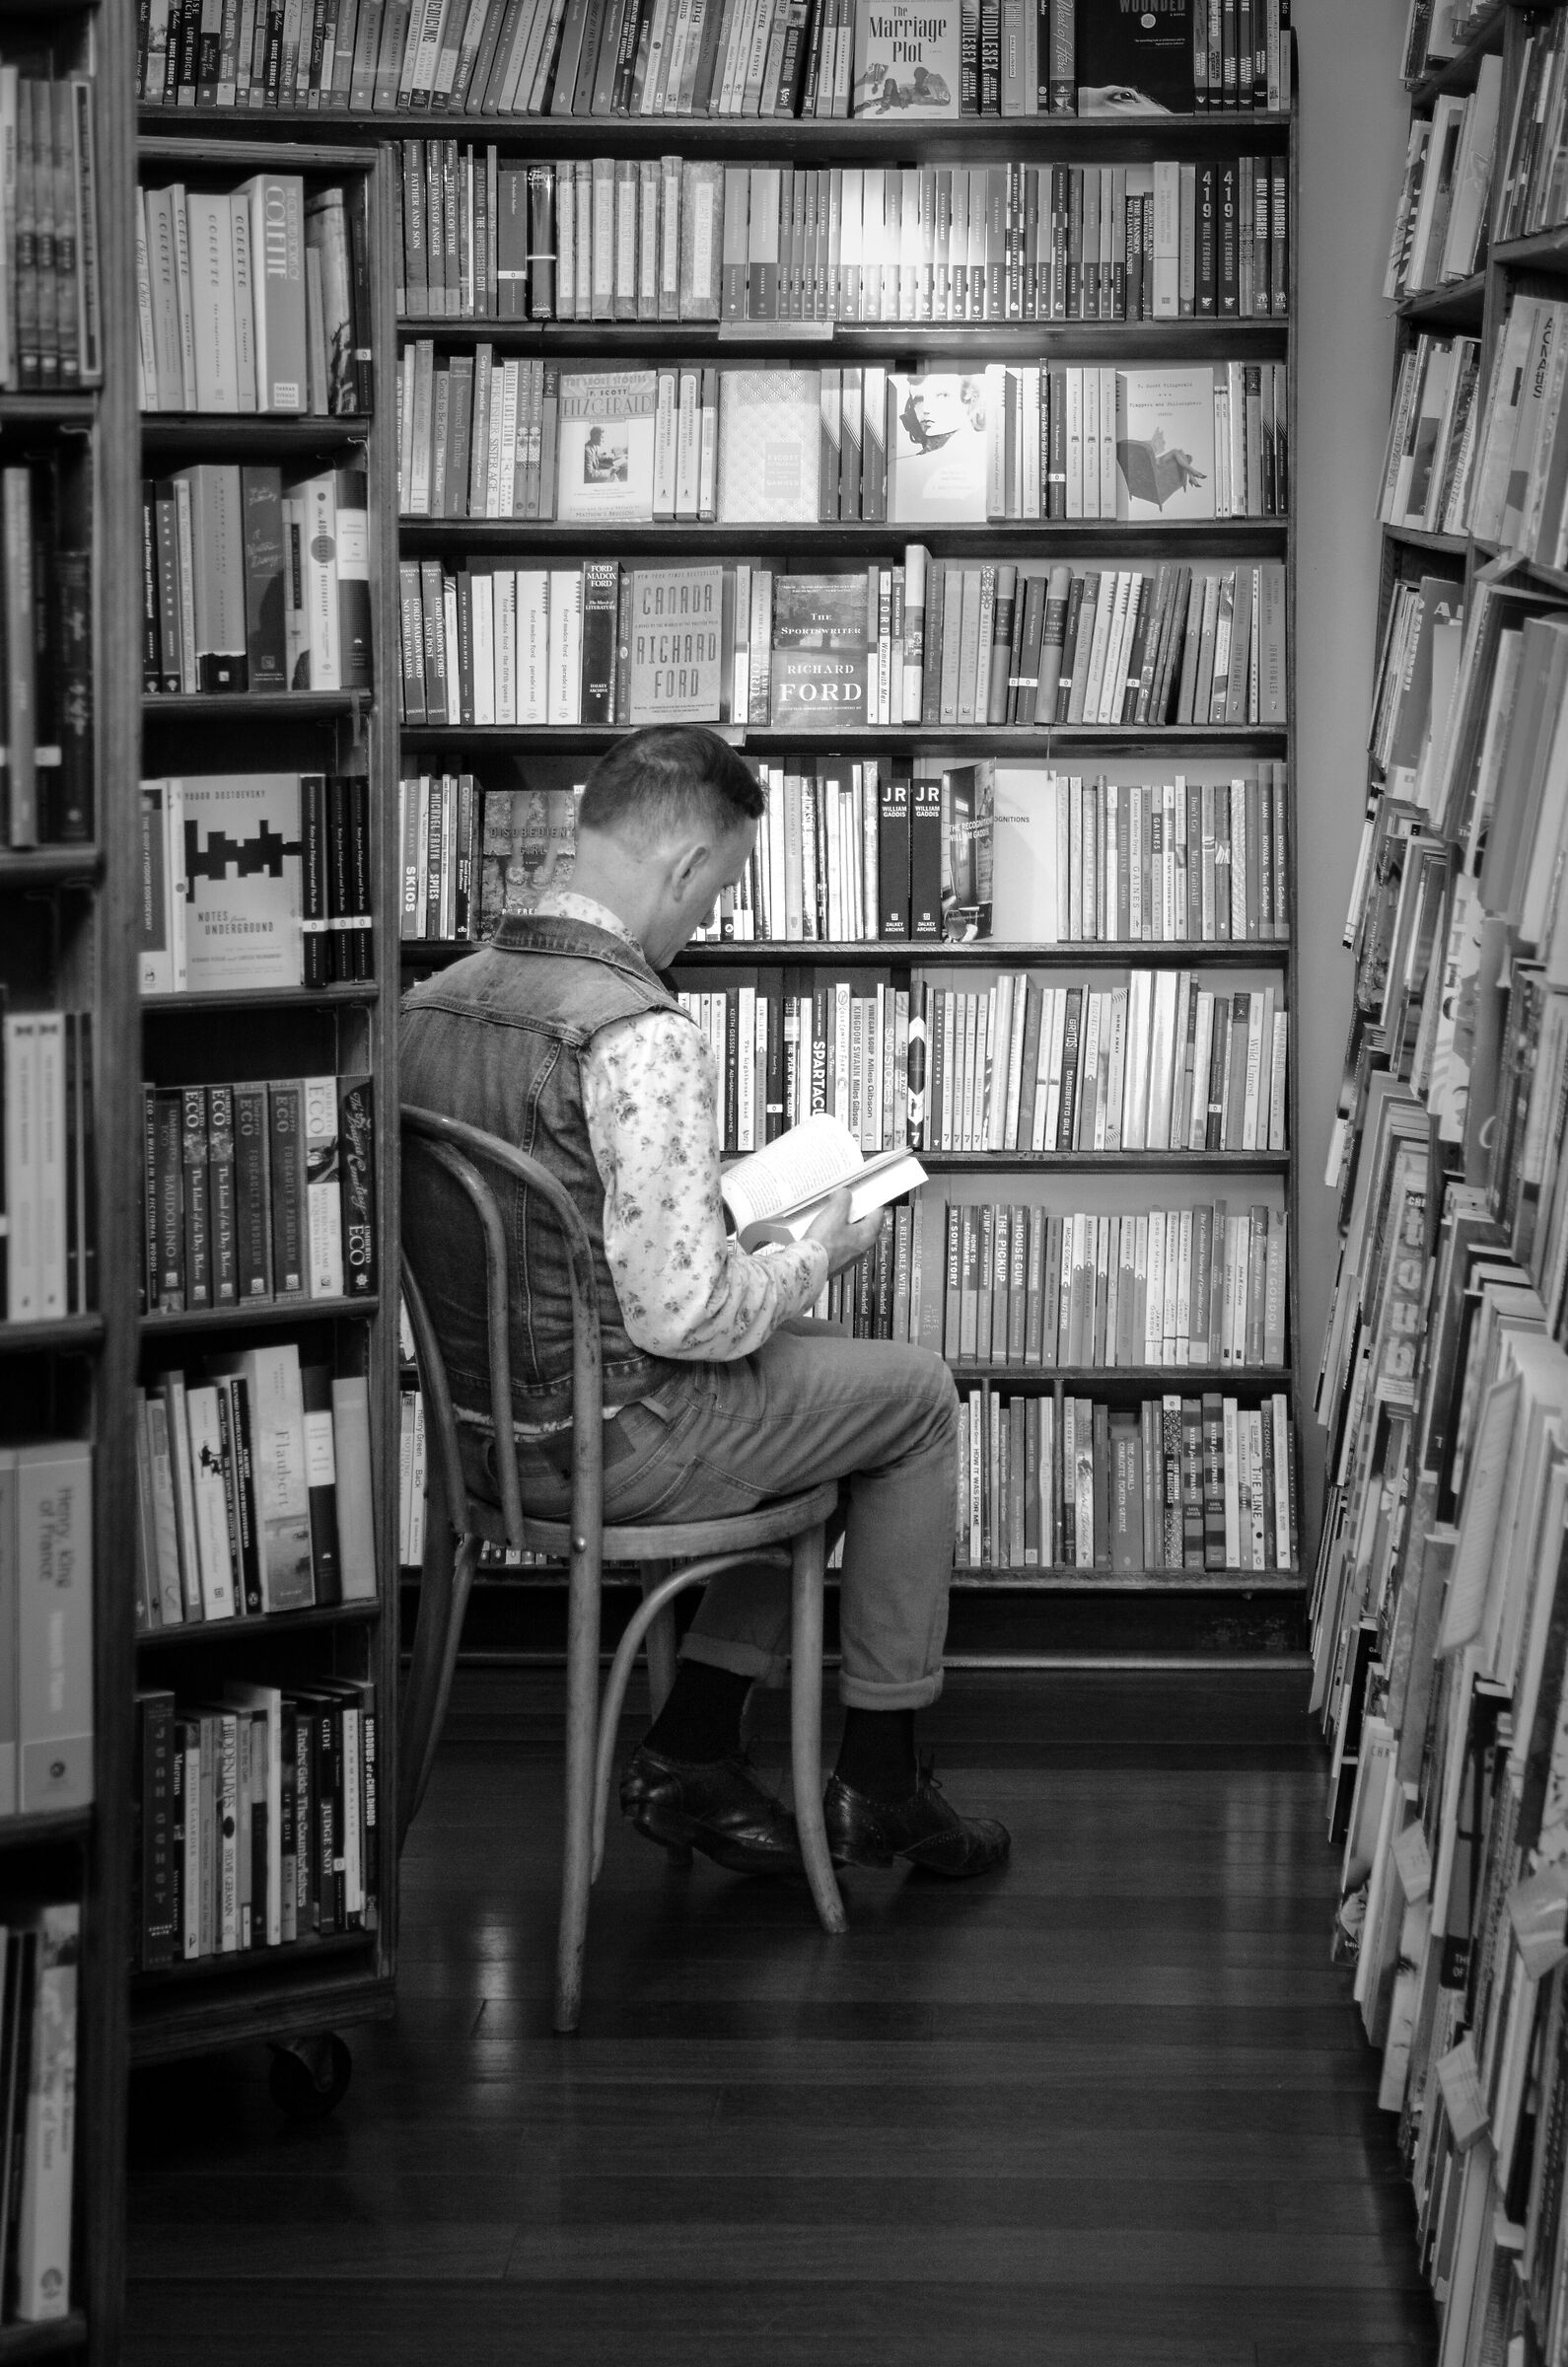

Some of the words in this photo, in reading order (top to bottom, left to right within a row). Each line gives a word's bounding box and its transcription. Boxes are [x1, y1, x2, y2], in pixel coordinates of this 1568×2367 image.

[892, 6, 908, 17] The
[1056, 0, 1074, 29] West
[1120, 0, 1185, 13] WOUNDED
[869, 16, 948, 43] Marriage
[962, 5, 976, 63] MIDDLESEX
[982, 5, 999, 71] MIDDLESEX
[1053, 30, 1073, 49] of
[786, 30, 799, 57] GOLEM
[892, 40, 923, 63] Plot
[183, 46, 193, 81] MEDICINE
[782, 58, 795, 82] SONG
[1055, 44, 1074, 74] Here
[431, 173, 440, 187] MY
[447, 177, 456, 194] THE
[476, 167, 486, 179] JON
[411, 173, 420, 206] FATHER
[431, 188, 440, 210] DAYS
[476, 181, 486, 208] FASMAN
[1223, 171, 1234, 218] 419
[1256, 179, 1268, 196] HOLY
[411, 209, 420, 229] AND
[431, 211, 440, 225] OF
[447, 196, 456, 218] FACE
[1256, 199, 1268, 239] RADISHES!
[265, 185, 287, 279] COLETTE
[447, 219, 456, 230] OF
[476, 216, 486, 229] THE
[1224, 222, 1233, 241] WILL
[159, 212, 171, 286] COLETTE
[235, 215, 247, 289] COLETTE
[411, 230, 420, 250] SON
[431, 226, 440, 256] ANGER
[447, 231, 456, 256] TIME
[476, 230, 486, 276] UNPOSSESSED
[1224, 243, 1233, 281] FERGUSON
[476, 276, 486, 292] CITY
[438, 378, 447, 400] Good
[438, 412, 447, 422] Be
[563, 394, 652, 416] FITZGERALD
[438, 424, 447, 441] God
[401, 599, 412, 611] NO
[412, 598, 422, 620] FORD
[642, 584, 712, 615] CANADA
[401, 613, 412, 639] MORE
[880, 597, 891, 634] FORD
[412, 622, 422, 653] MADOX
[780, 626, 861, 635] SPORTSWRITER
[401, 640, 412, 680] PARADES
[636, 633, 716, 665] RICHARD
[880, 642, 889, 669] Women
[412, 655, 422, 679] FORD
[787, 664, 855, 675] RICHARD
[880, 671, 889, 686] with
[654, 669, 699, 699] FORD
[779, 682, 862, 701] FORD
[880, 688, 889, 704] Men
[882, 786, 906, 803] JR
[915, 786, 940, 803] JR
[1190, 796, 1199, 818] Don't
[430, 793, 441, 828] MICHAEL
[1190, 820, 1199, 833] Cry
[430, 833, 441, 860] FRAYN
[1190, 849, 1199, 869] Mary
[405, 866, 416, 912] SKIOS
[430, 874, 441, 899] SPIES
[1190, 871, 1199, 906] Gaitskill
[197, 910, 229, 923] NOTES
[204, 921, 274, 936] UNDERGROUND
[852, 1006, 861, 1044] KINGDOM
[885, 1027, 893, 1052] SAD
[852, 1046, 861, 1077] SWANN
[813, 1041, 825, 1116] SPARTACU
[852, 1079, 861, 1100] Miles
[885, 1054, 893, 1106] STORIES
[1064, 1070, 1073, 1116] DAGOBERTO
[184, 1091, 198, 1128] ECO
[212, 1088, 225, 1126] ECO
[240, 1099, 253, 1136] ECO
[275, 1095, 289, 1132] ECO
[852, 1101, 861, 1127] Gibson
[169, 1110, 178, 1161] UMBERTO
[149, 1167, 156, 1178] IN
[164, 1175, 178, 1257] BAUDOLINO
[950, 1209, 959, 1223] MY
[998, 1213, 1008, 1235] THE
[348, 1224, 366, 1266] ECO
[898, 1226, 907, 1270] RELIABLE
[950, 1225, 959, 1252] SON'S
[1015, 1224, 1024, 1260] HOUSE
[998, 1240, 1008, 1282] PICKUP
[1268, 1240, 1278, 1273] MARY
[950, 1255, 959, 1286] STORY
[1015, 1261, 1024, 1286] GUN
[898, 1272, 907, 1297] WIFE
[1268, 1277, 1278, 1331] GORDON
[275, 1429, 292, 1507] Flaubert
[1251, 1467, 1263, 1487] THE
[1251, 1492, 1263, 1520] LINE
[973, 1514, 980, 1527] ME
[321, 1718, 331, 1752] GIDE
[365, 1718, 376, 1763] SHADOWS
[296, 1766, 309, 1795] Gide
[296, 1796, 309, 1824] The
[366, 1777, 376, 1827] CHILDHOOD
[321, 1802, 333, 1846] JUDGE
[296, 1823, 309, 1908] Counterfeiters
[322, 1847, 333, 1877] NOT
